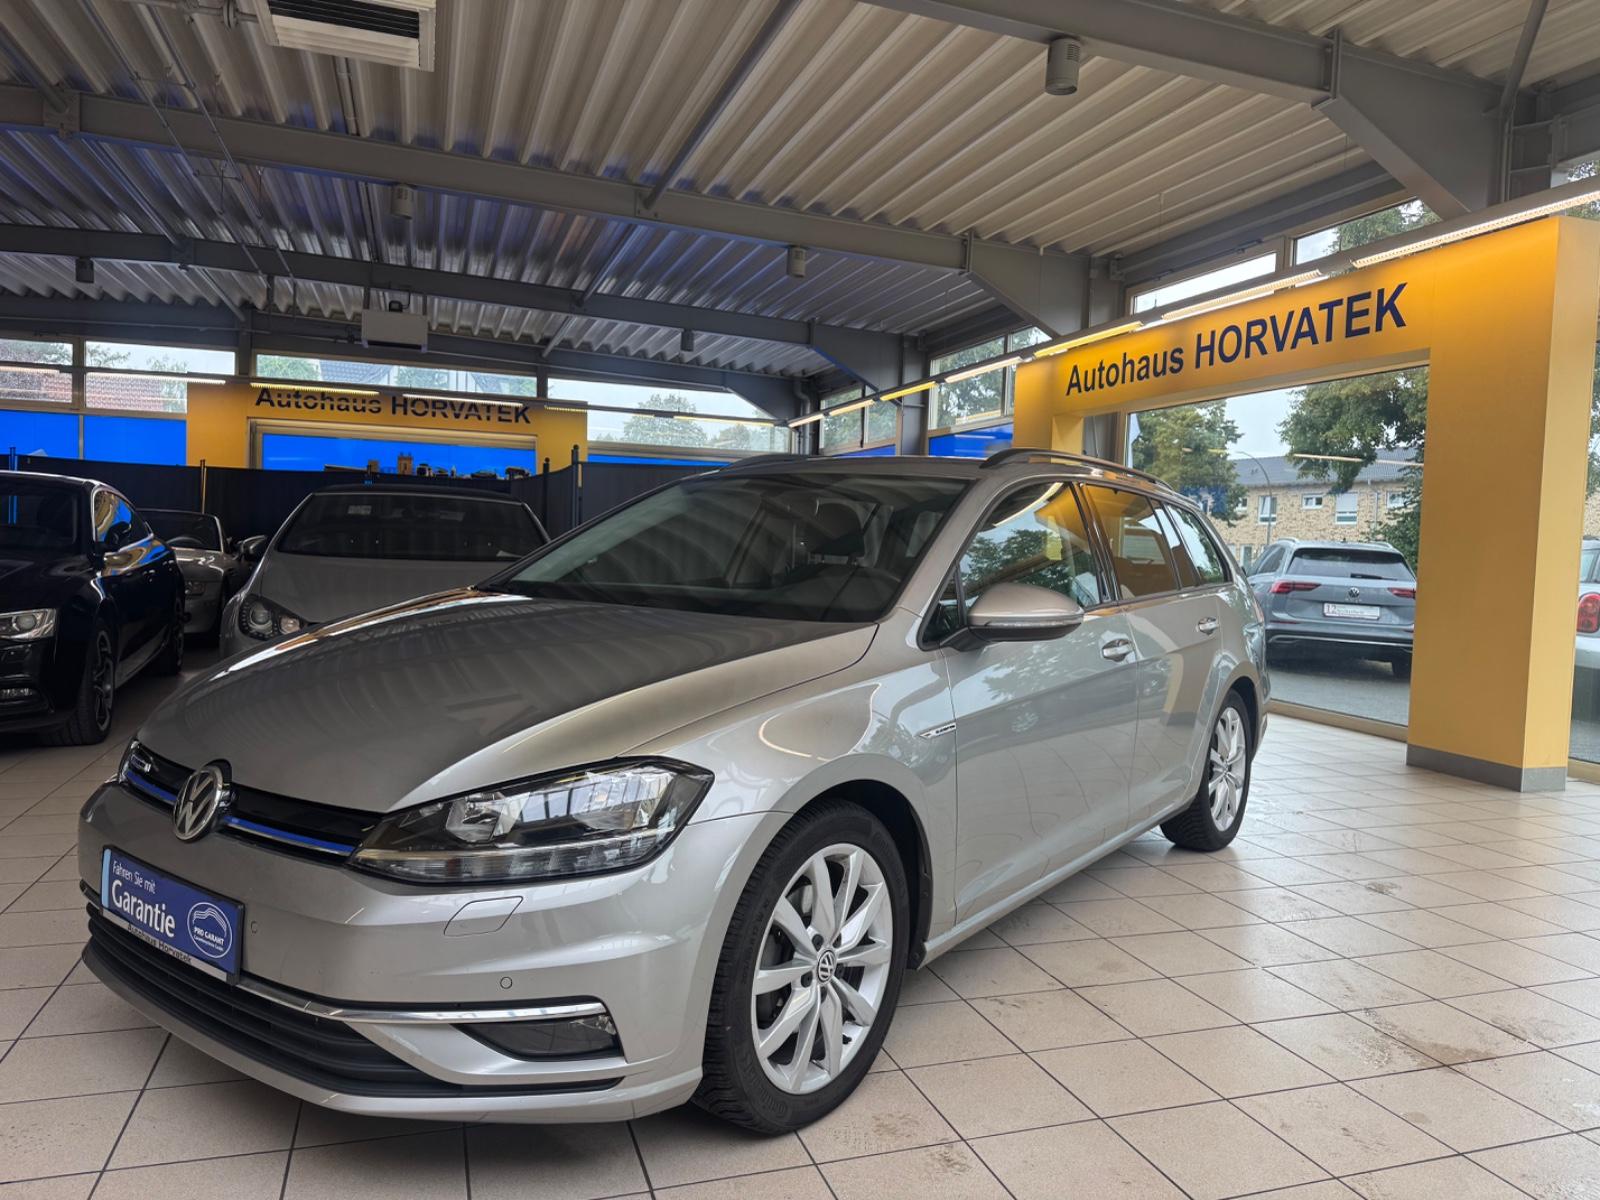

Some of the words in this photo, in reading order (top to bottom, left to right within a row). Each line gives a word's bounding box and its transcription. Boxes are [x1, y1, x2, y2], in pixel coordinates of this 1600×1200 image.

[1065, 346, 1184, 396] Autohaus
[1194, 282, 1408, 369] HORVATEK
[254, 387, 382, 414] Autohaus
[391, 395, 531, 424] HORVATEK
[112, 860, 133, 881] Fahren
[134, 871, 143, 888] Sie
[144, 880, 156, 895] mit
[111, 879, 176, 938] Garantie
